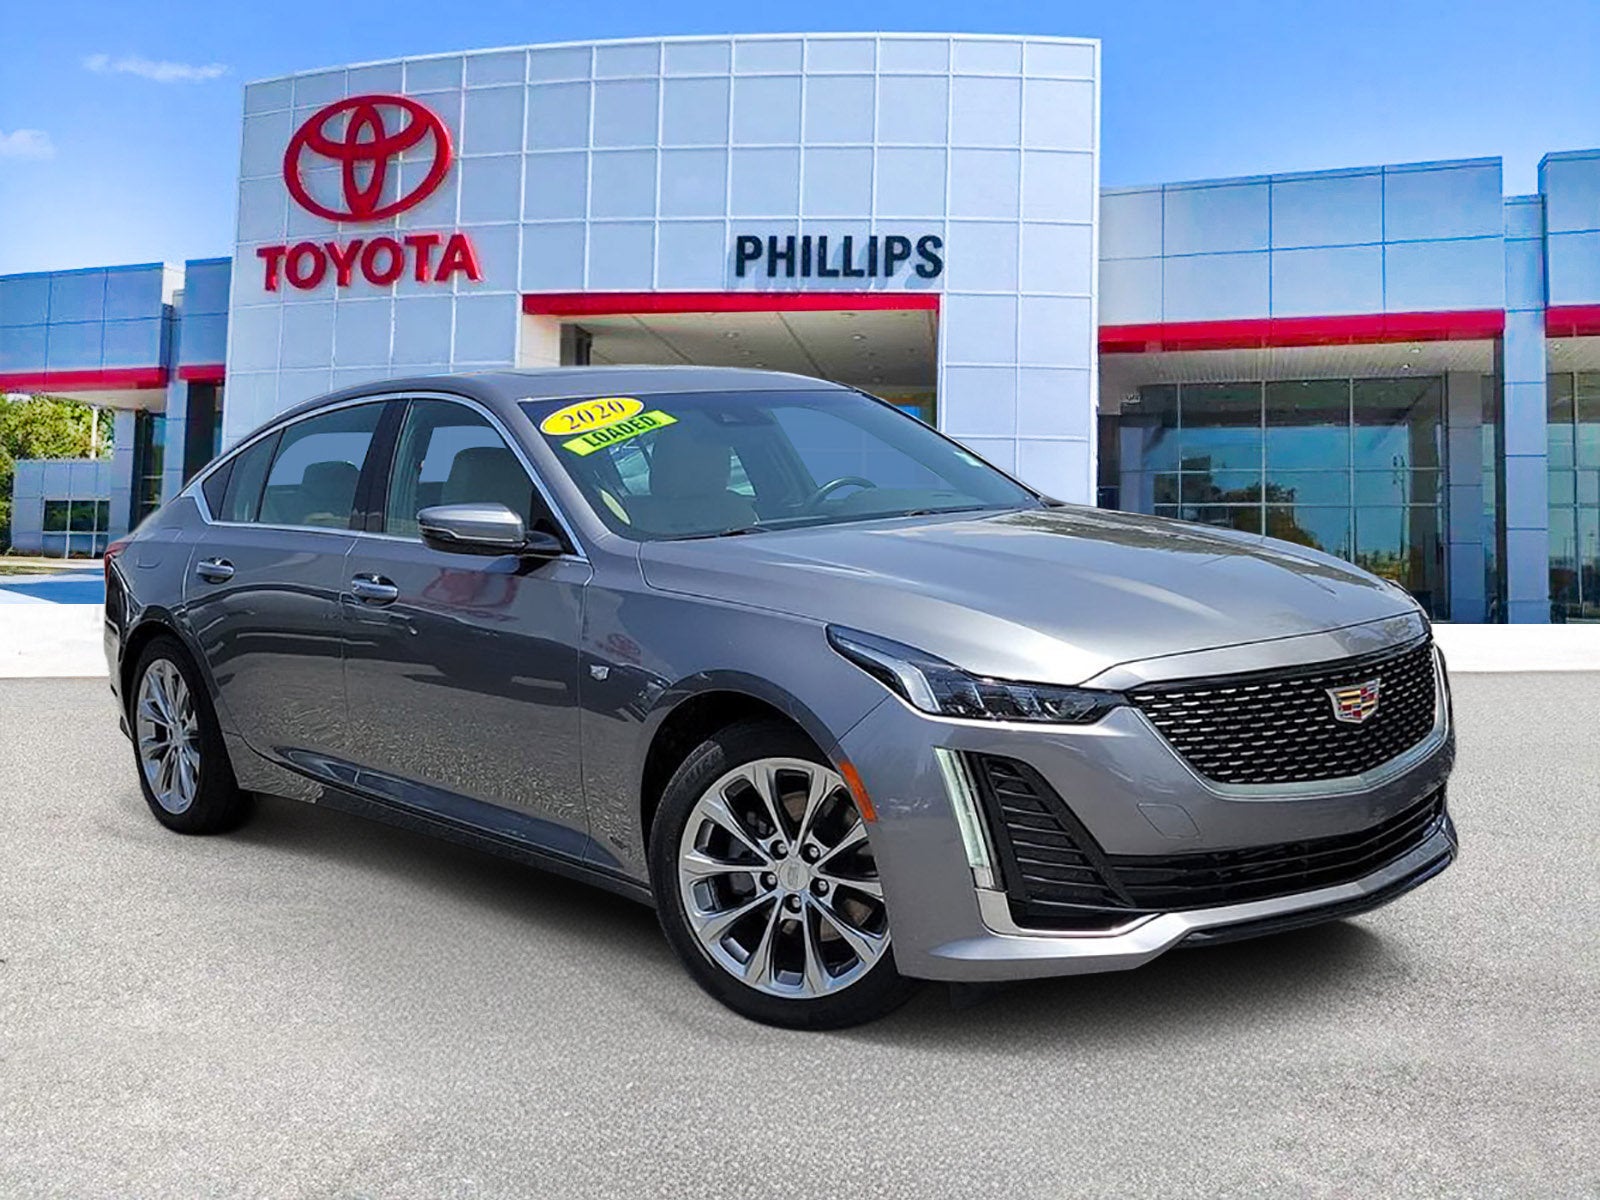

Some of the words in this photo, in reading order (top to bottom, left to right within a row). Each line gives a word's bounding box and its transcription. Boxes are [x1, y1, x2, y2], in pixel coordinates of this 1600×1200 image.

[256, 234, 483, 292] TOYOTA
[735, 235, 943, 279] PHILLIPS
[562, 400, 626, 430] 2020
[582, 415, 658, 447] LOADED
